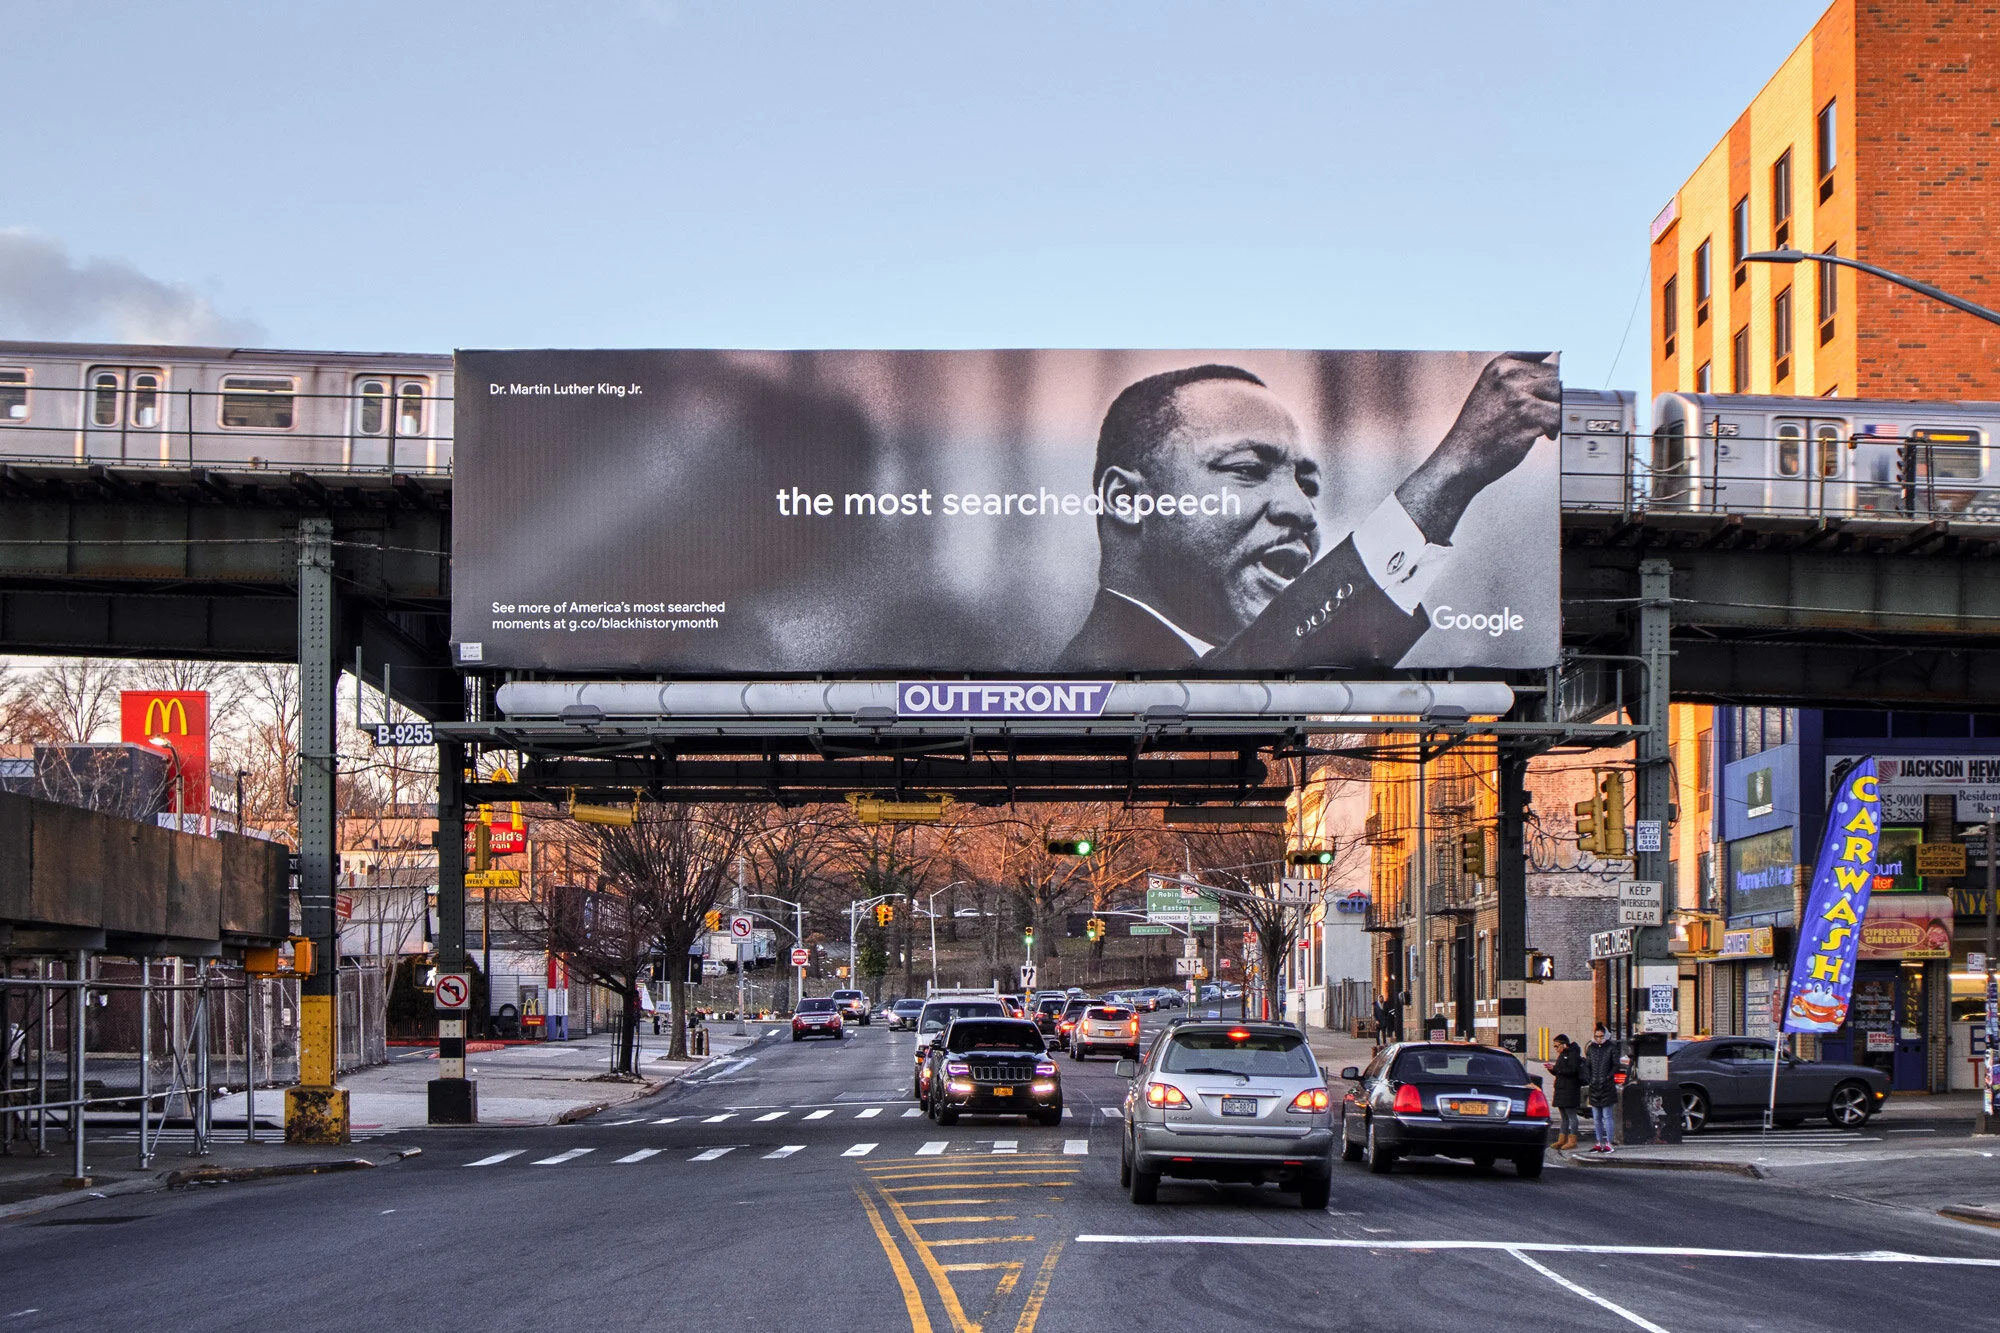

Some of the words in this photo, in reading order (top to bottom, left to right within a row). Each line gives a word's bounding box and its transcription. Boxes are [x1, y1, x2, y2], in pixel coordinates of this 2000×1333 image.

[490, 383, 507, 395] Dr.
[510, 383, 550, 395] Martin
[554, 383, 594, 395] Luther
[598, 383, 625, 397] King
[628, 383, 643, 395] Jr.
[776, 487, 833, 515] the
[845, 489, 932, 515] most
[942, 487, 1104, 515] searched
[1115, 487, 1241, 523] speech
[492, 602, 515, 613] See
[518, 604, 551, 613] more
[553, 602, 567, 613] of
[569, 602, 630, 613] America's
[633, 603, 665, 613] most
[668, 602, 725, 613] searched
[492, 619, 550, 629] moments
[553, 619, 566, 629] at
[569, 617, 718, 631] g.co/blackhistorymonth
[1432, 605, 1524, 637] Google
[904, 685, 1102, 711] OUTFRONT
[378, 724, 433, 745] B-9255
[1900, 759, 1963, 777] JACKSON
[1921, 845, 1962, 855] OFFICIAL
[1629, 886, 1652, 896] KEEP
[1621, 899, 1660, 908] INTERSECTION
[1625, 911, 1655, 921] CLEAR
[1863, 928, 1898, 936] CYPRESS
[1900, 928, 1920, 936] HILLS
[1594, 933, 1611, 956] HOTEL
[1866, 936, 1883, 944] CAR
[1885, 936, 1918, 944] CENTER
